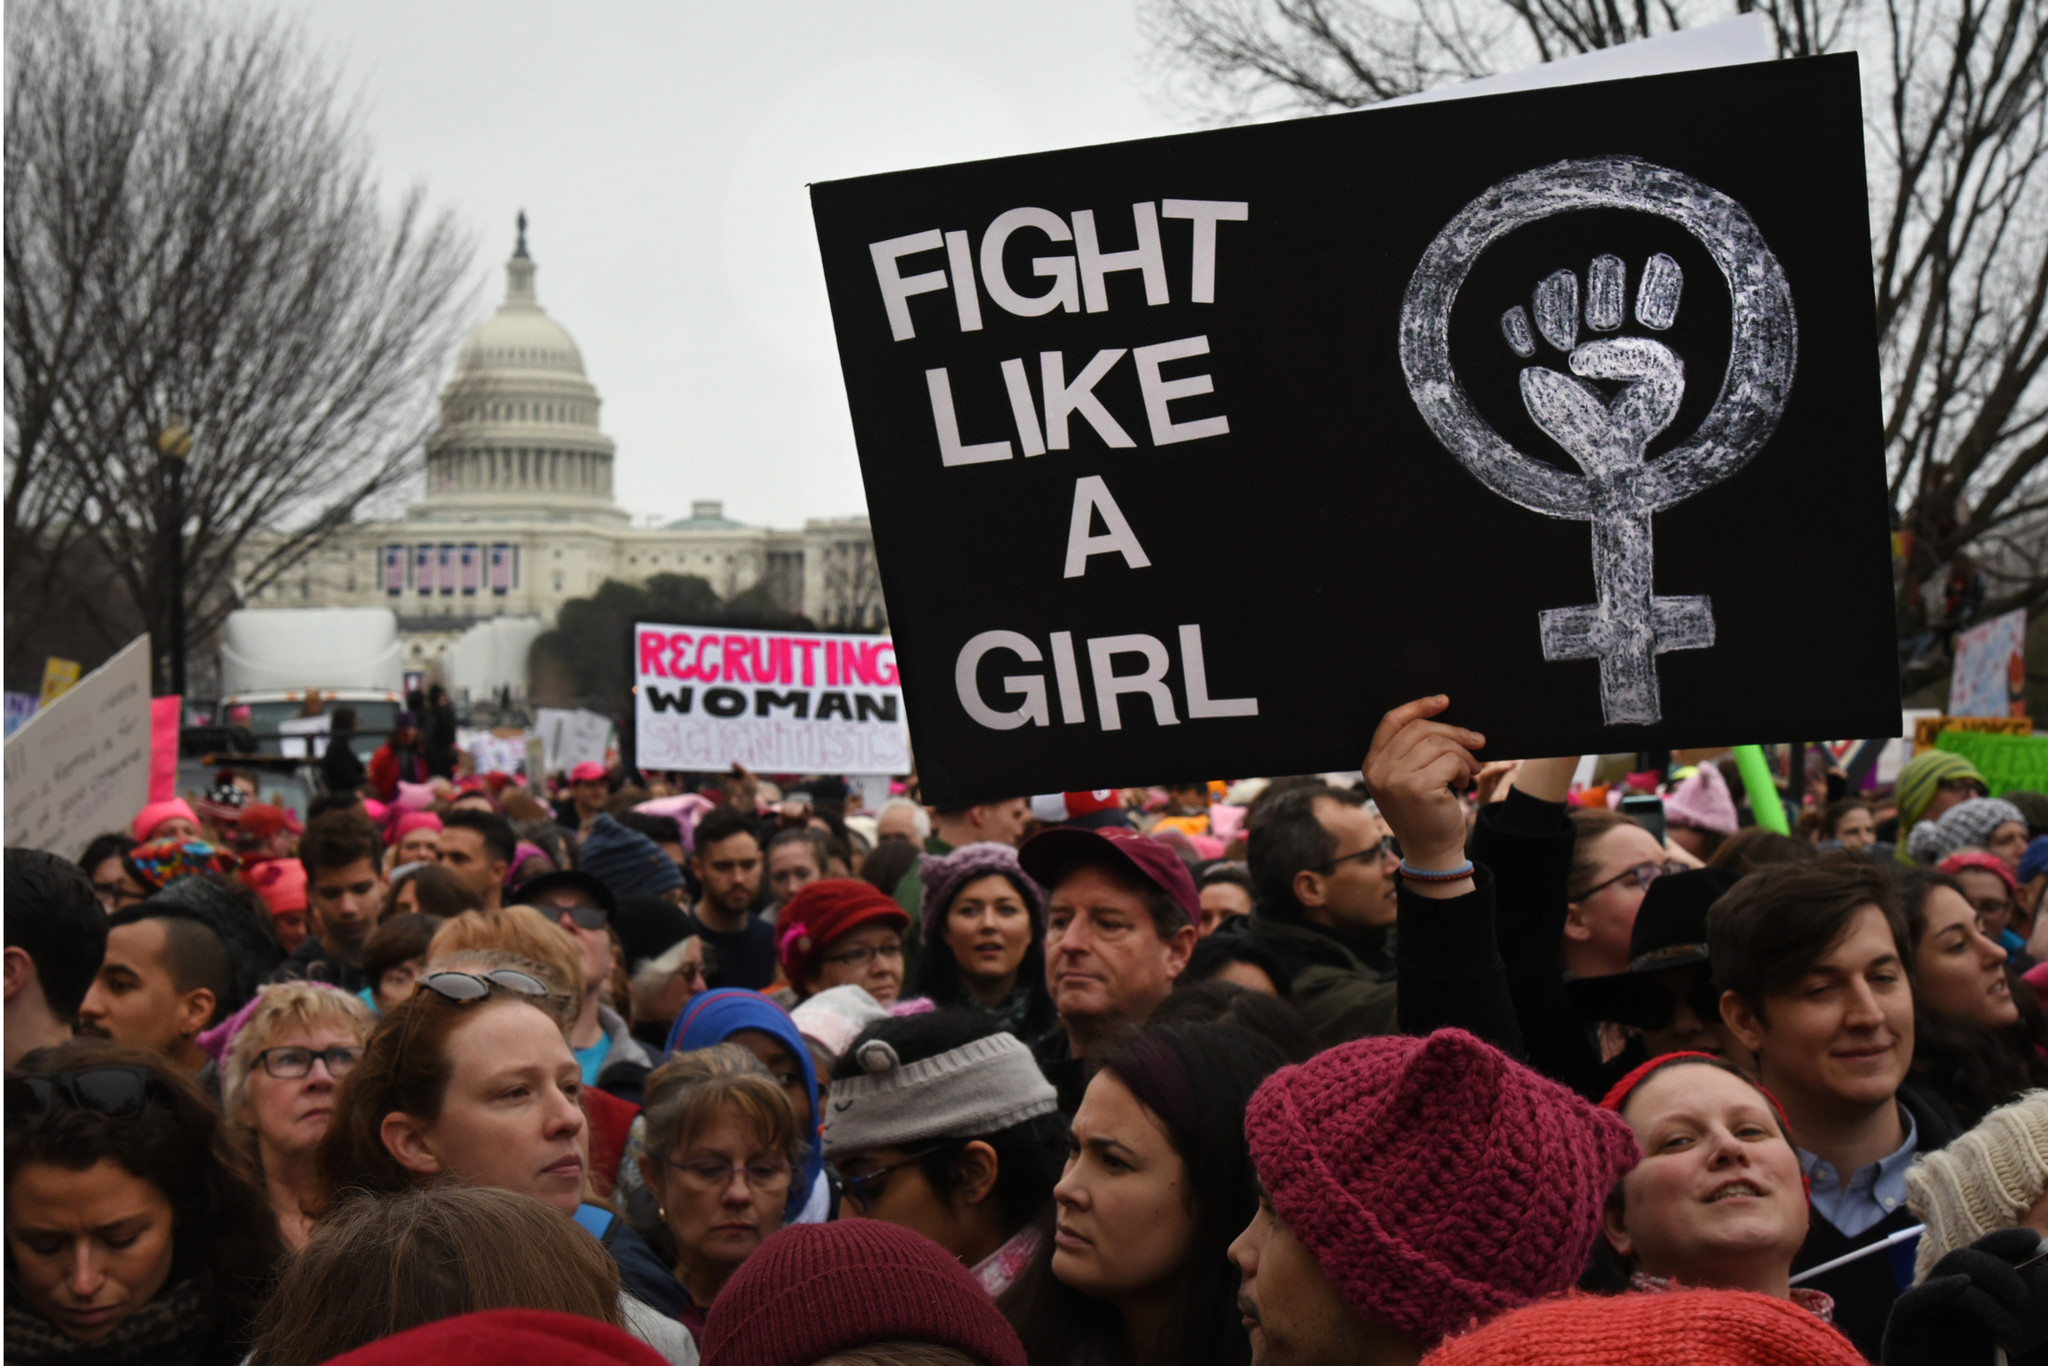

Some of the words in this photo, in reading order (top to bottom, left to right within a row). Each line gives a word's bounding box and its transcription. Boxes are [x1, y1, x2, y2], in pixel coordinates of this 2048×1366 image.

[869, 199, 1248, 341] FIGHT
[926, 335, 1229, 466] LIKE
[1064, 476, 1151, 578] A
[638, 631, 900, 687] RECRUITING
[646, 686, 897, 722] WOMAN
[956, 625, 1258, 730] GIRL
[640, 718, 909, 767] SCIENTISTS
